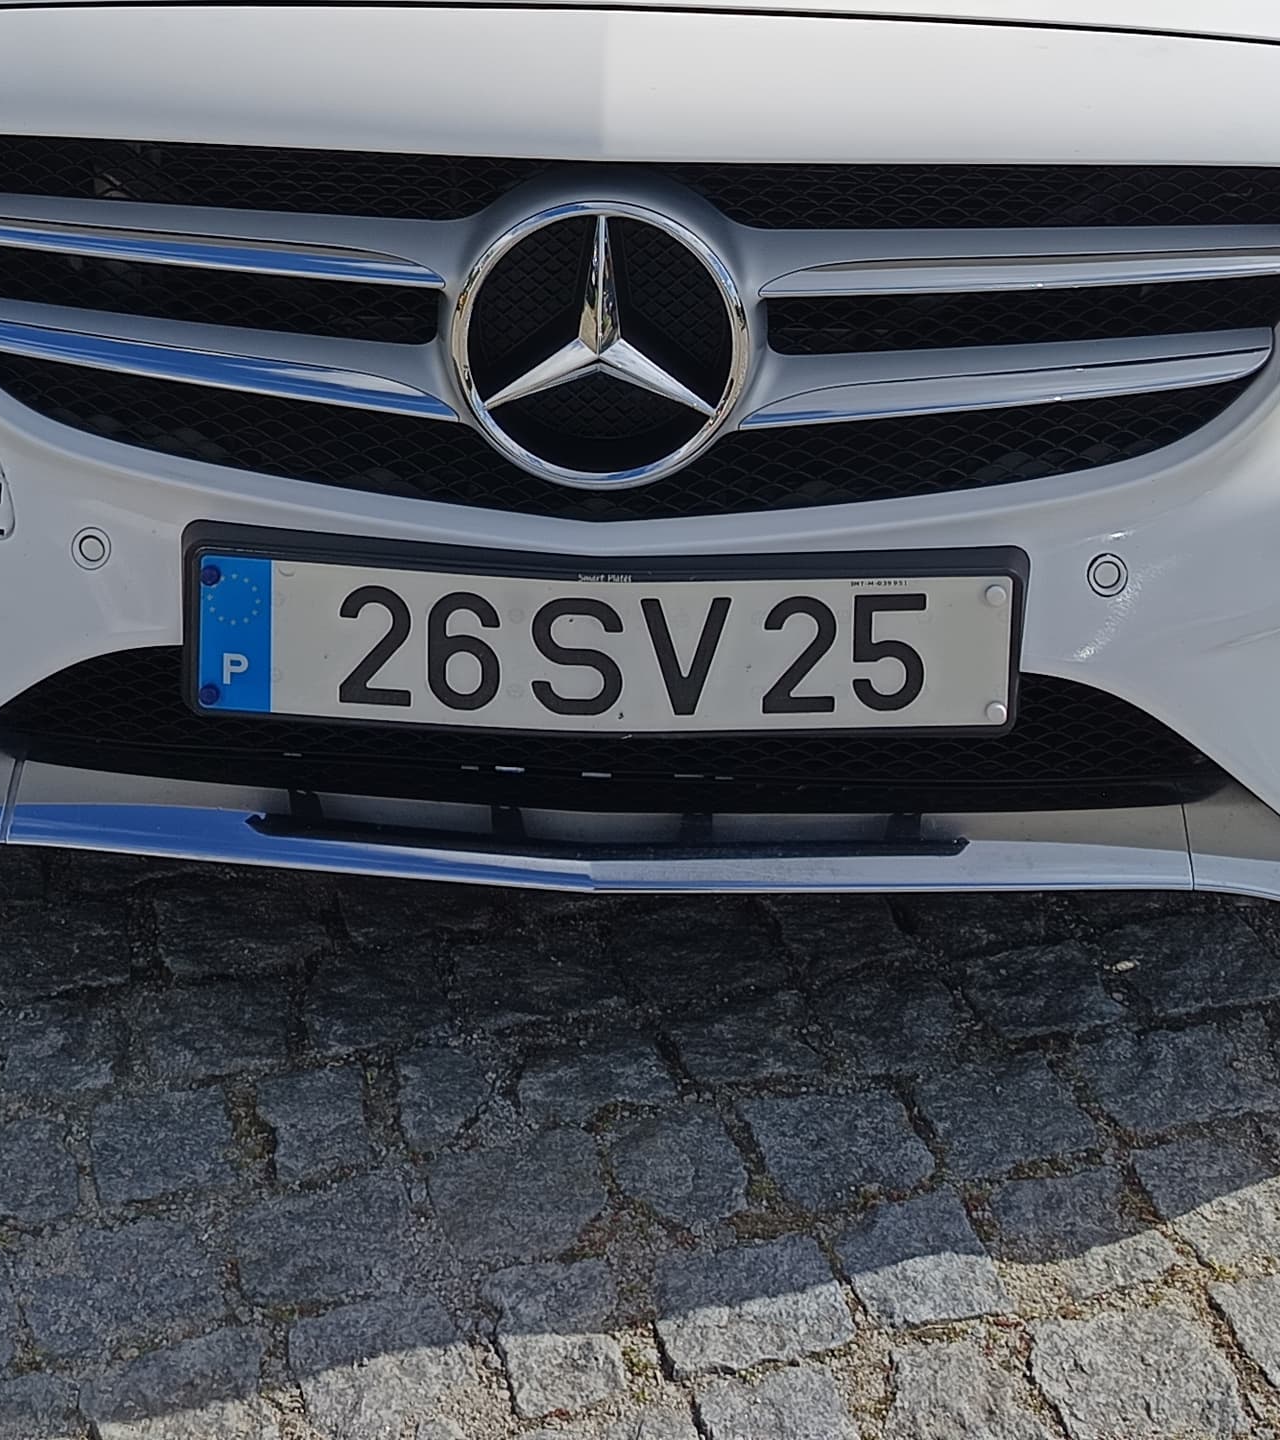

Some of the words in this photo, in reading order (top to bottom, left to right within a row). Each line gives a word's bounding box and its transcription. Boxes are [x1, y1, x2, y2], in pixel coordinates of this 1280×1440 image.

[223, 653, 248, 684] P
[338, 584, 501, 711] 26
[531, 596, 732, 717] SV
[761, 592, 927, 715] 25
